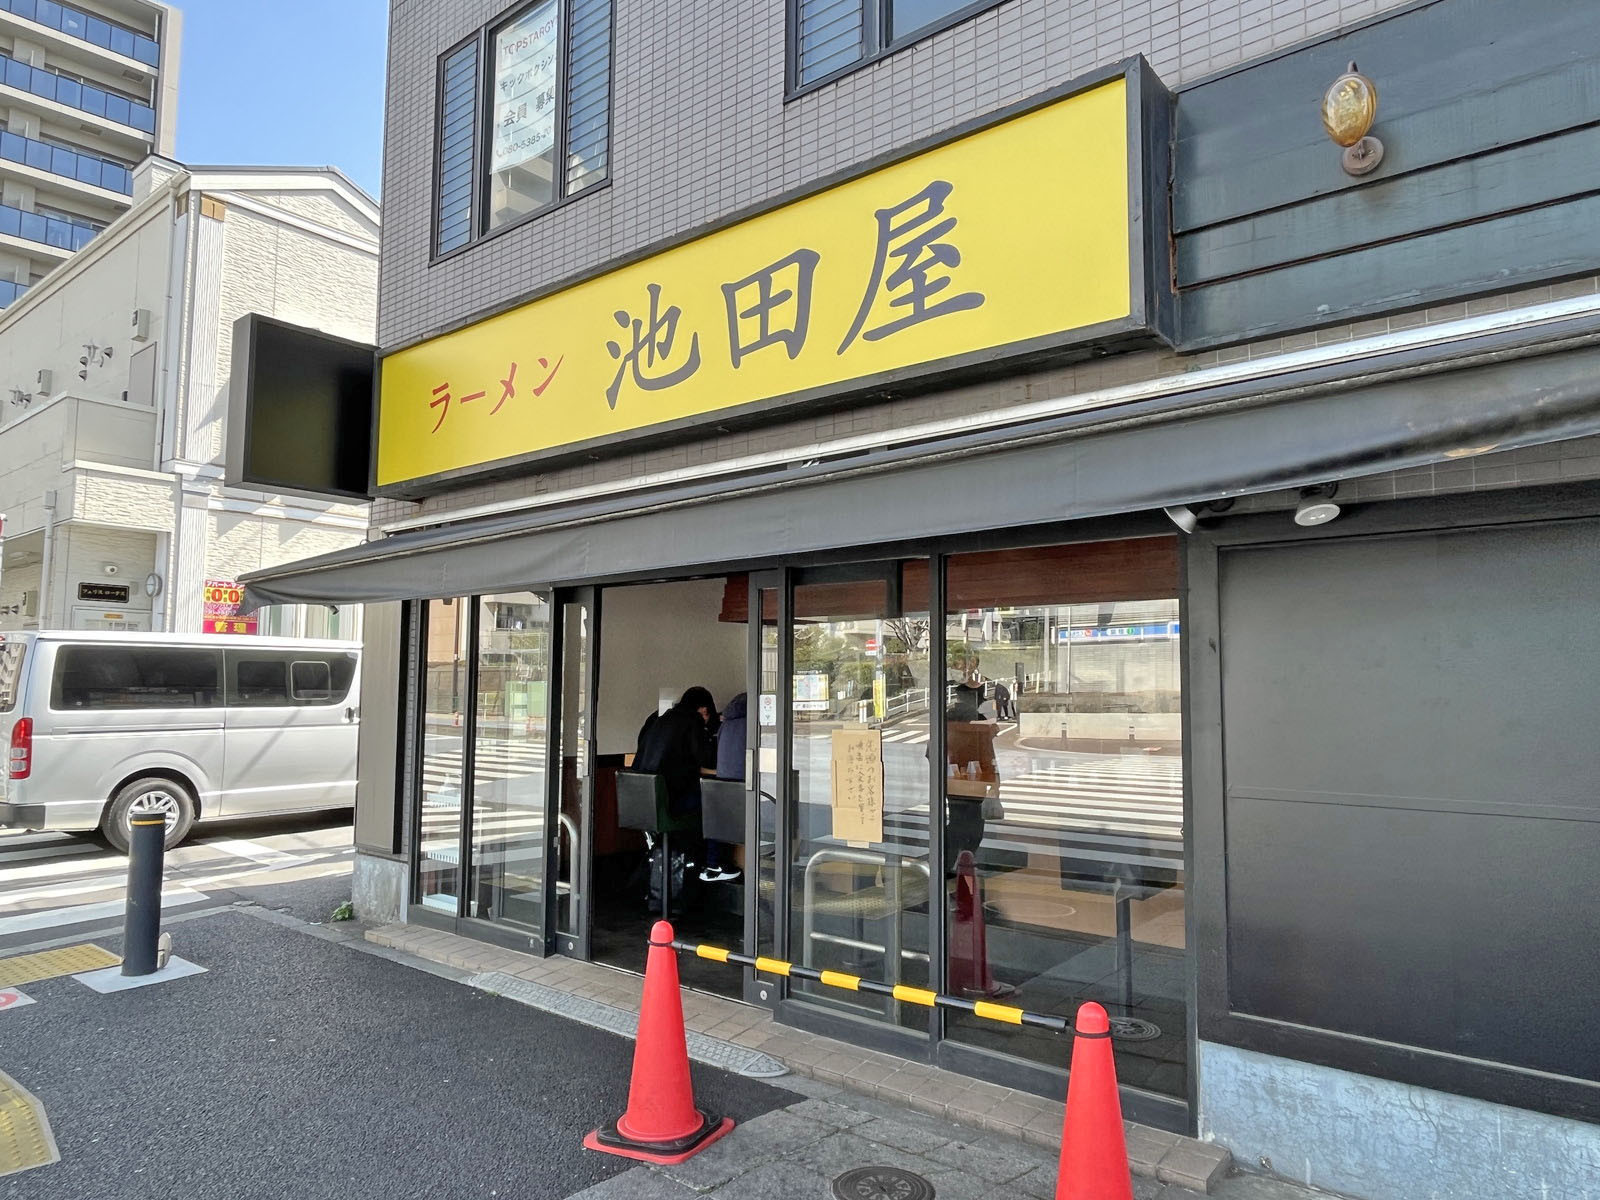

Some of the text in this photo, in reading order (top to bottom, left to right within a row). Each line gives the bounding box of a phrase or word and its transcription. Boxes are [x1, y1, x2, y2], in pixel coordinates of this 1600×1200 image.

[503, 102, 527, 127] 会員
[429, 180, 985, 434] ラーメン 池田屋
